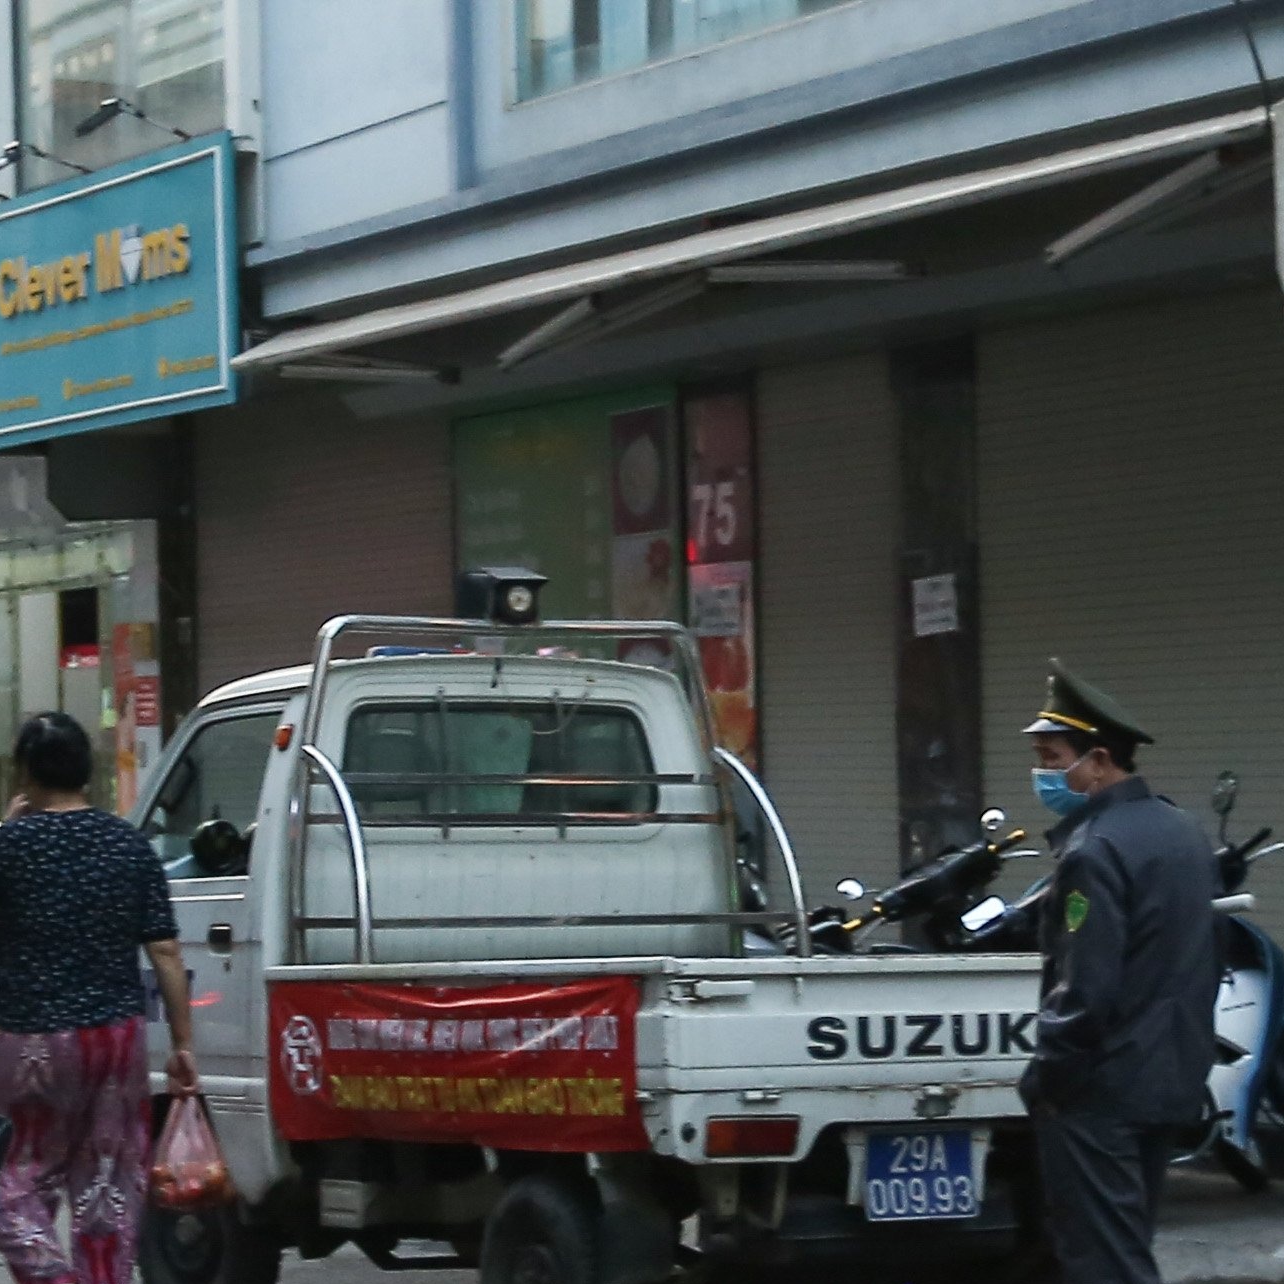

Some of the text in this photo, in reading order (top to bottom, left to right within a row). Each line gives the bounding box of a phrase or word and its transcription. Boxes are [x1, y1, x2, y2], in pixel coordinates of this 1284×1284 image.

[807, 1012, 1039, 1061] SUZUK
[890, 1135, 948, 1173] 29A
[868, 1175, 975, 1216] 009.93
